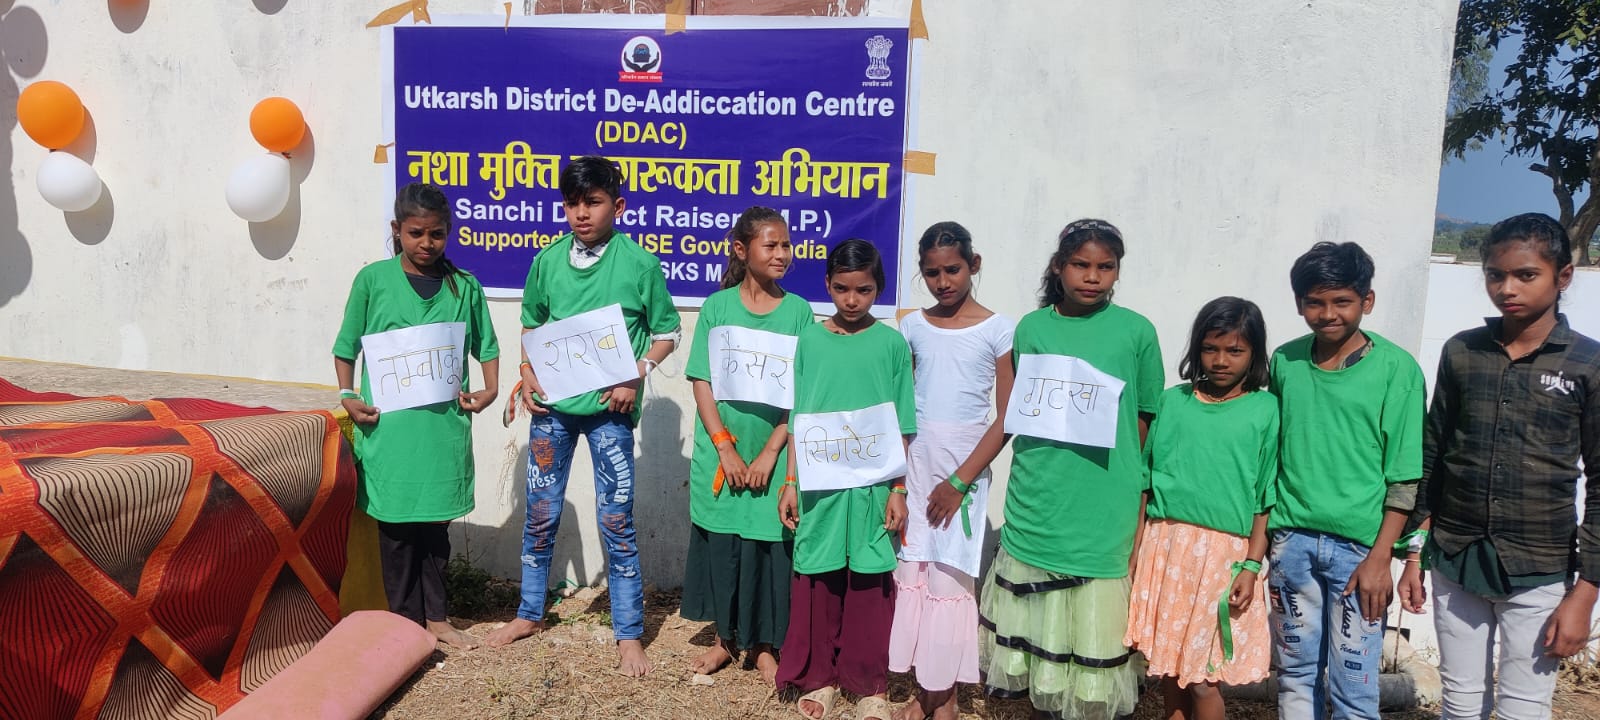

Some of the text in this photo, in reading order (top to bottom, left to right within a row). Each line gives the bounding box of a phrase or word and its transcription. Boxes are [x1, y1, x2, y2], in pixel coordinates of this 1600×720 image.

[404, 85, 895, 117] Utkarsh District De-Addiccation Centre
[595, 121, 687, 149] (DDAC)
[407, 141, 890, 200] नशा मुक्ति गरूकता अभियान
[455, 198, 542, 223] Sanchi
[378, 345, 462, 396] तम्बाकू
[541, 323, 621, 373] शराब
[800, 425, 887, 466] सिगरेट
[606, 445, 631, 504] THUNDER
